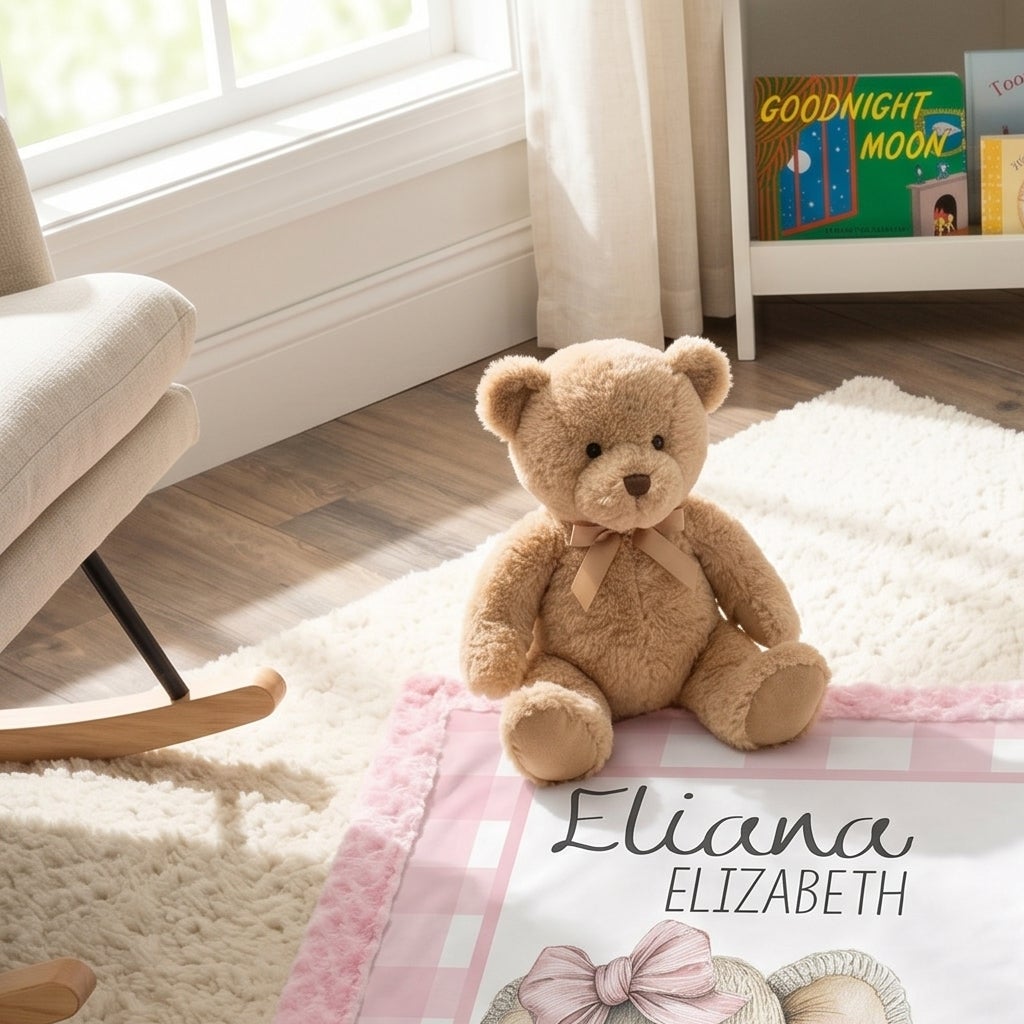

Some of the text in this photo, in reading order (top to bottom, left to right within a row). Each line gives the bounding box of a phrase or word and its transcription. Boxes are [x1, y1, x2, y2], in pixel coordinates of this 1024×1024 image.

[760, 91, 933, 123] GOODNIGHT
[860, 130, 951, 161] MOON
[551, 785, 914, 859] Eliana
[665, 866, 908, 916] ELIZABETH
